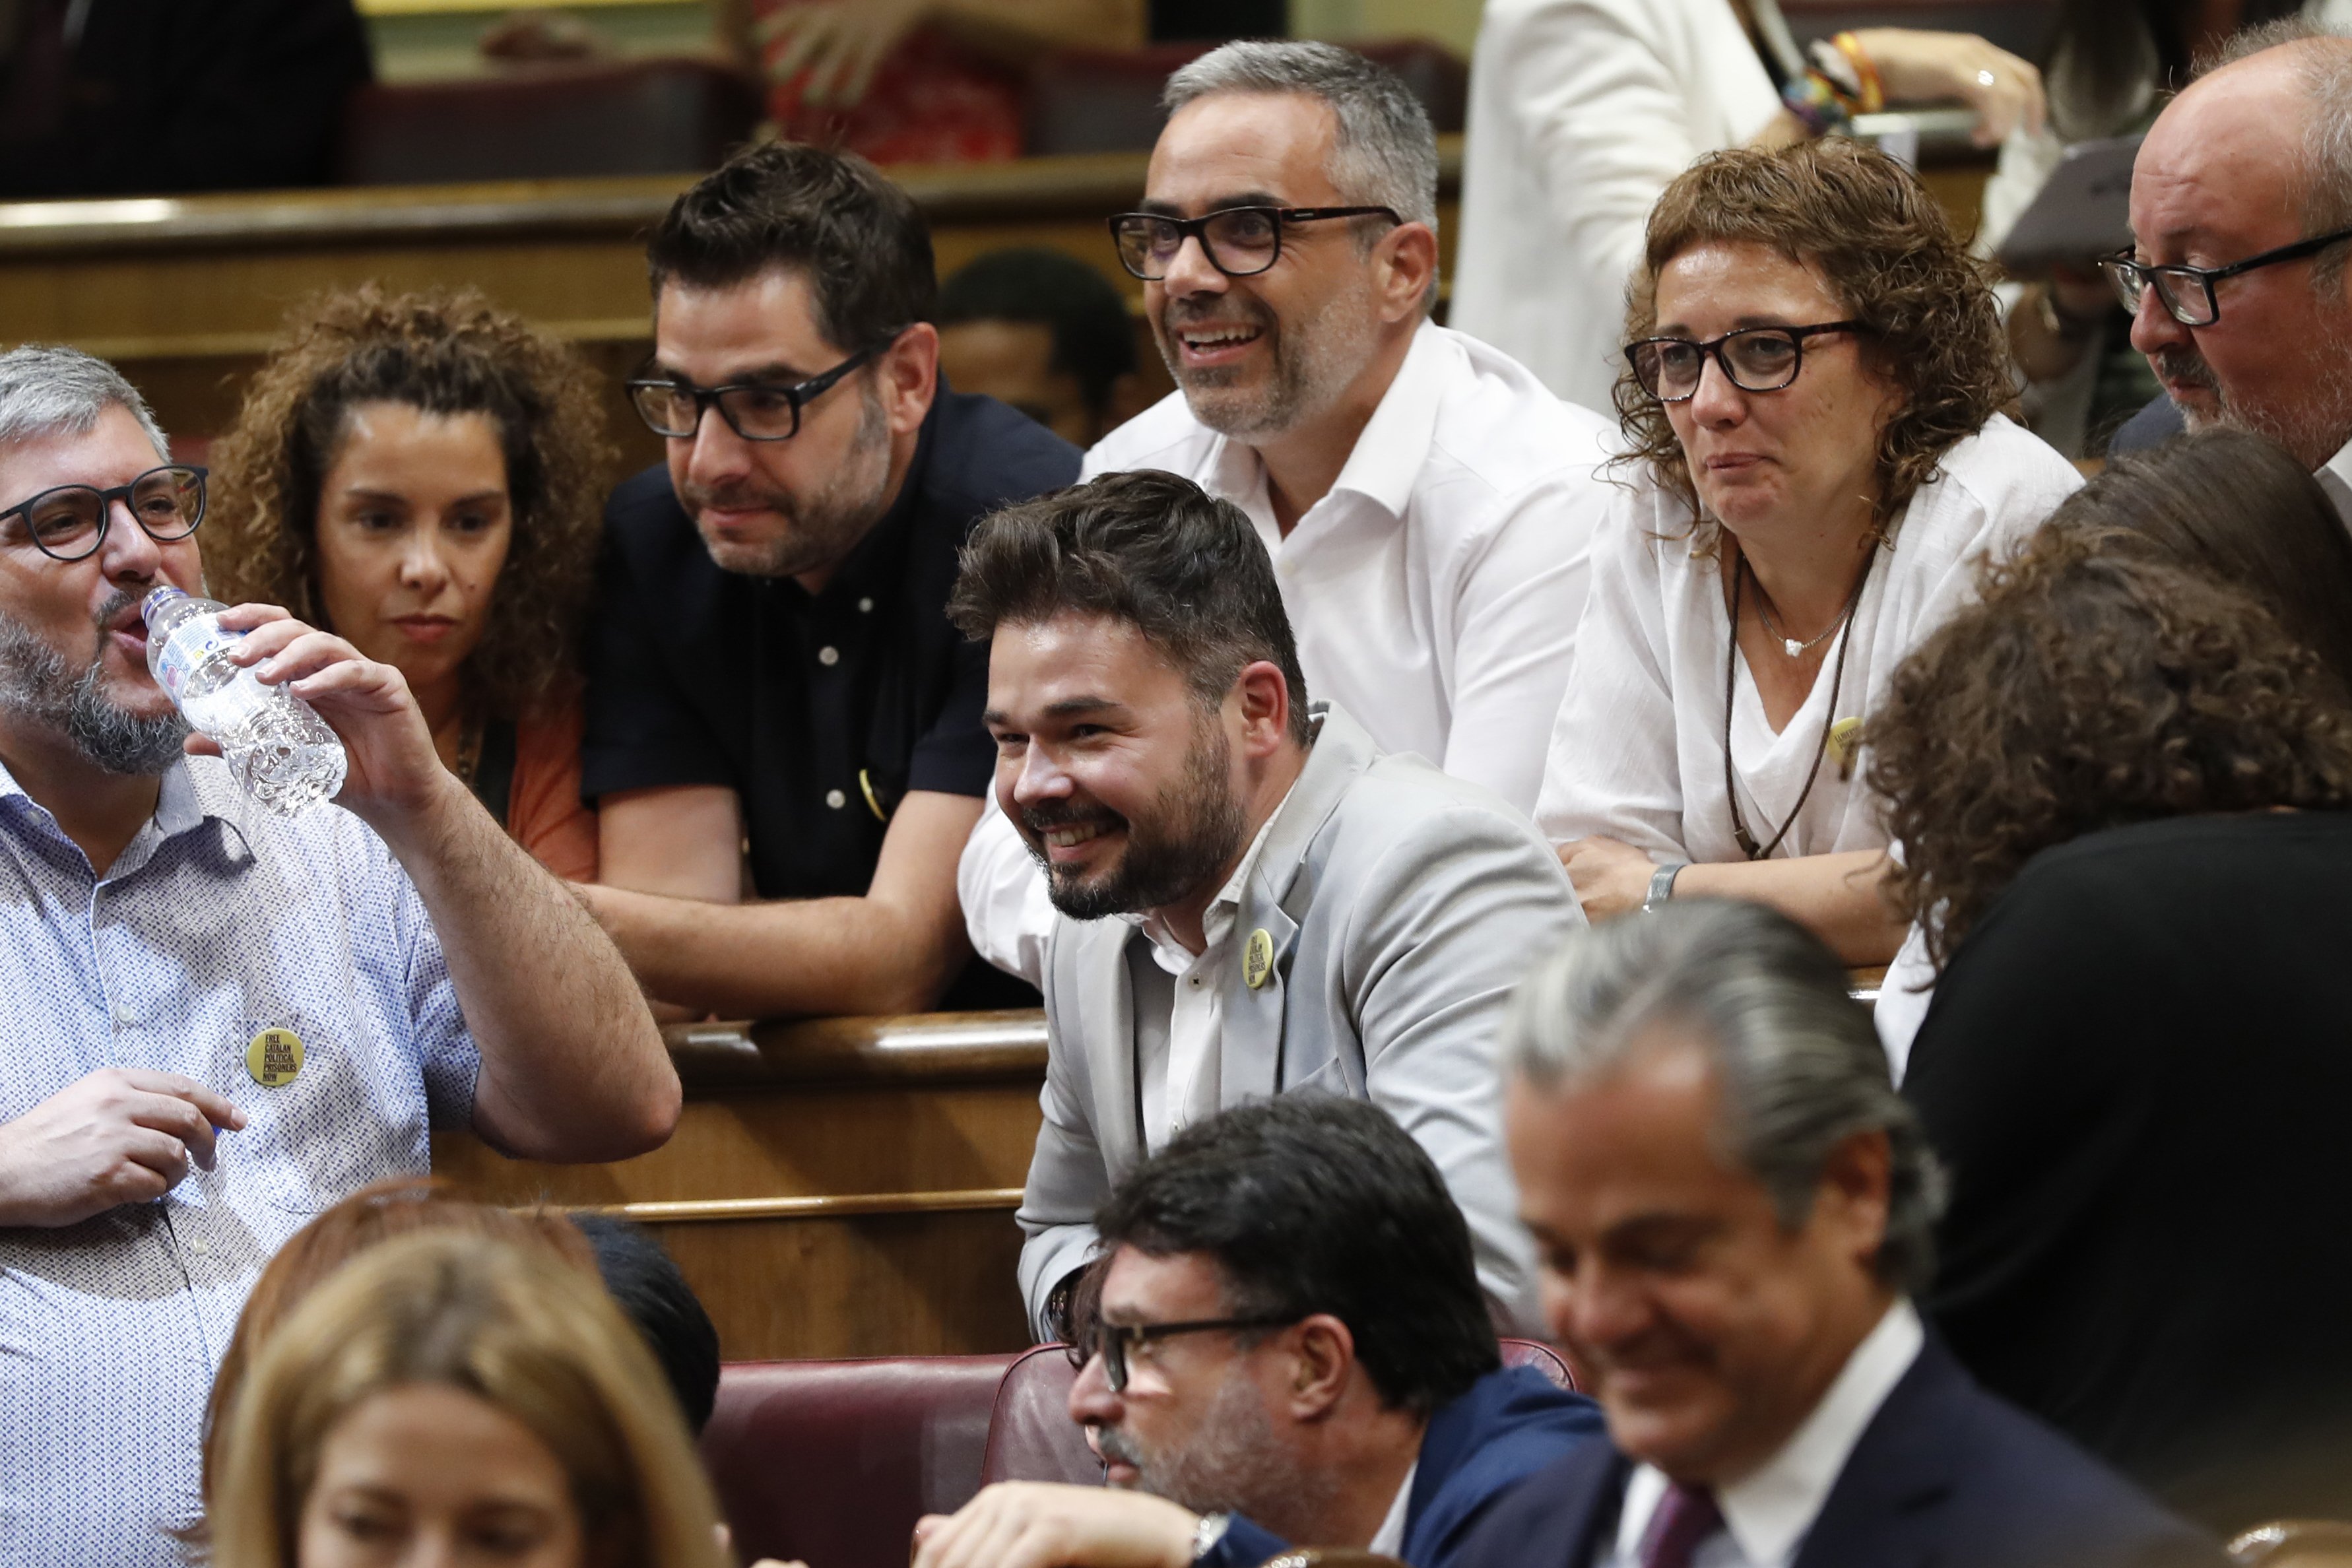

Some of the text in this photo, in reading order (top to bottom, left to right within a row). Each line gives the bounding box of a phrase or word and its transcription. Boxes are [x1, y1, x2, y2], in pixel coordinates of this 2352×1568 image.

[265, 1034, 280, 1043] FREE
[265, 1044, 291, 1053] CATALAN
[264, 1053, 294, 1062] POLITICAL
[263, 1062, 297, 1072] PRISONERS
[263, 1072, 277, 1081] NOW
